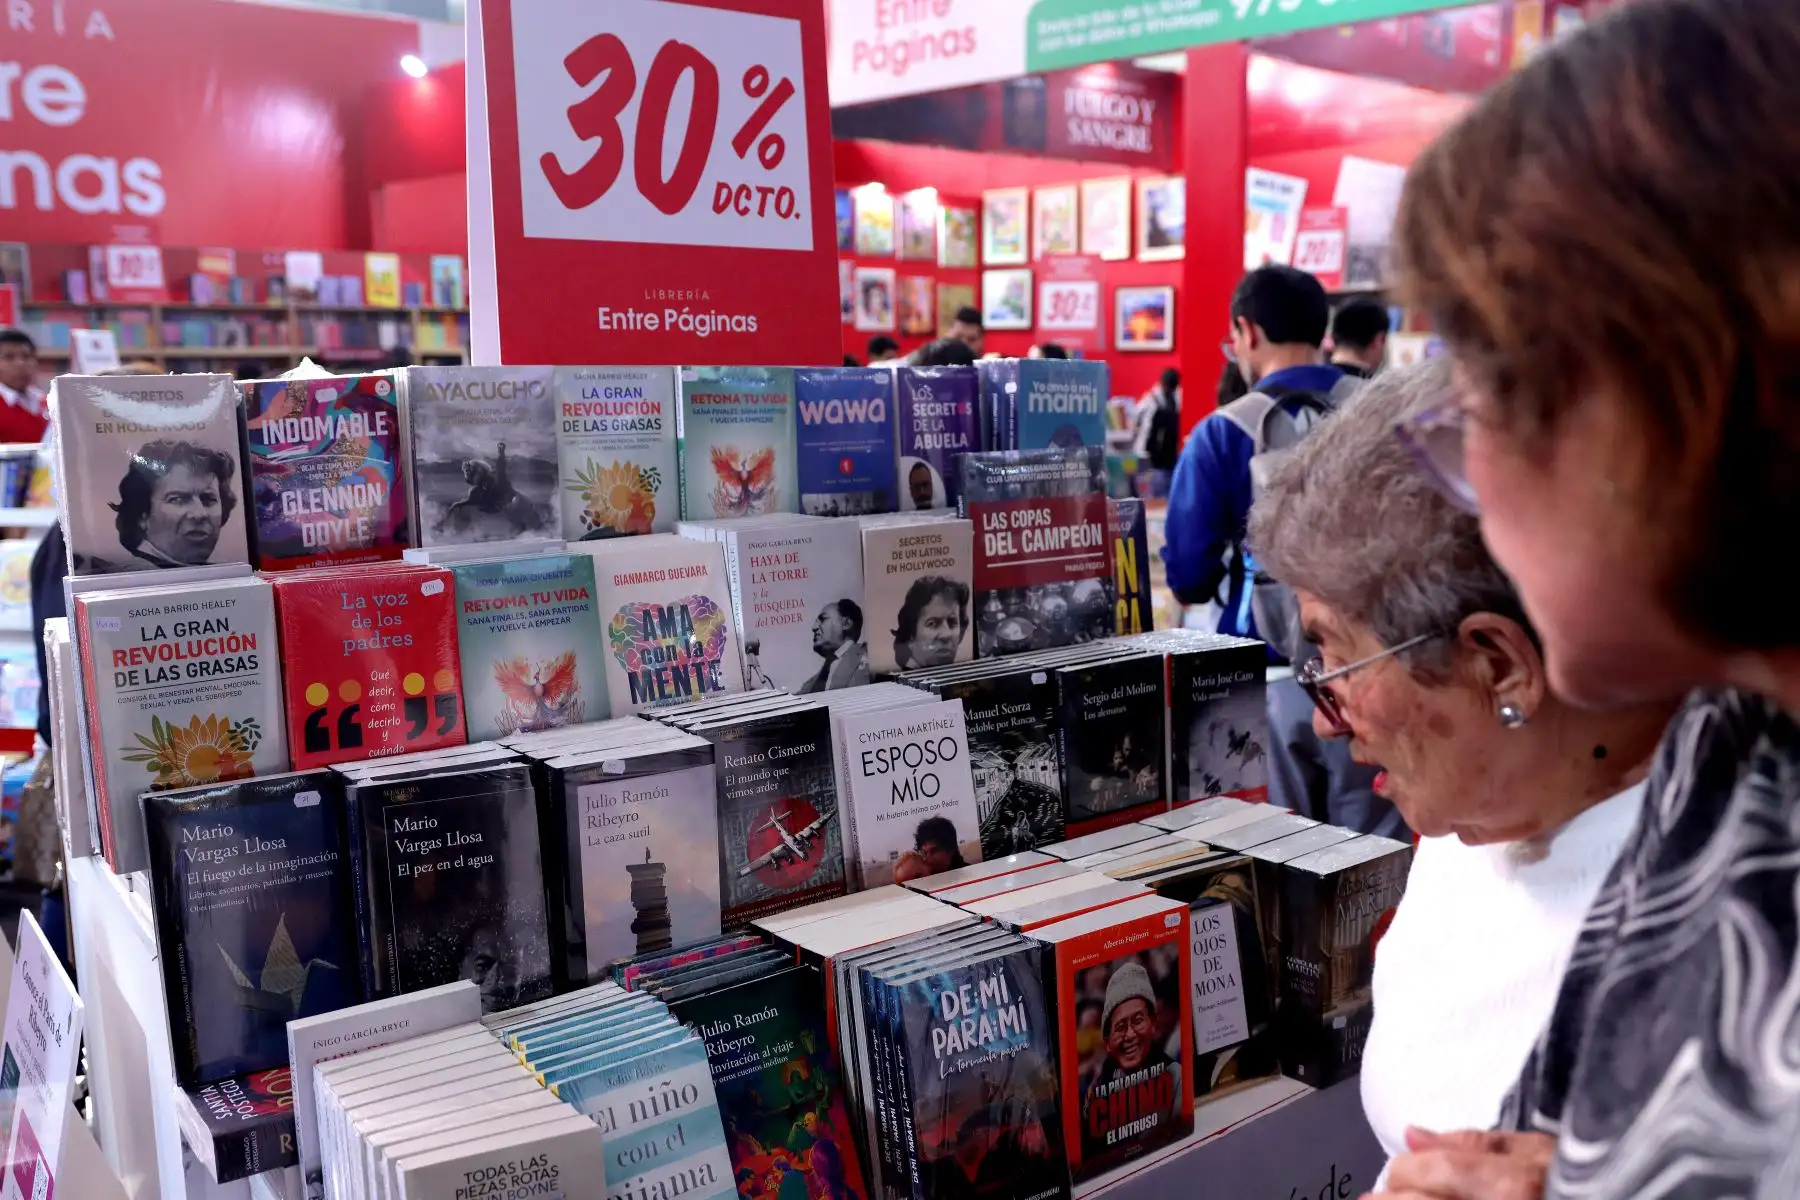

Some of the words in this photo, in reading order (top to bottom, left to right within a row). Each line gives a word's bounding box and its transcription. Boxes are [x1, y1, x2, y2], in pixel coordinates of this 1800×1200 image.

[852, 26, 978, 76] Páginas
[1064, 87, 1137, 123] FUEGO
[1138, 97, 1156, 125] Y
[0, 150, 166, 217] nas
[711, 181, 801, 220] DCTO.
[645, 288, 710, 301] LIBRERÍA
[598, 306, 660, 333] Entre
[664, 303, 758, 338] Páginas
[423, 380, 547, 402] AYACUCHO
[582, 388, 600, 400] LA
[604, 386, 643, 399] GRAN
[1028, 387, 1098, 415] mami
[562, 398, 662, 417] REVOLUCIÓN
[798, 398, 887, 426] wawa
[261, 411, 389, 446] INDOMABLE
[562, 420, 580, 433] DE
[583, 419, 609, 432] LAS
[611, 418, 663, 432] GRASAS
[914, 432, 970, 450] ABUELA
[986, 475, 1004, 484] CLUB
[1005, 471, 1052, 483] UNIVERSITARIO
[281, 483, 384, 517] GLENNON
[301, 516, 371, 548] DOYLE
[983, 511, 1008, 531] LAS
[1011, 507, 1052, 528] COPAS
[898, 534, 943, 549] SECRETOS
[985, 531, 1018, 557] DEL
[1021, 519, 1104, 553] CAMPEÓN
[750, 554, 782, 568] HAYA
[784, 551, 801, 564] DE
[891, 549, 904, 561] DE
[904, 549, 918, 560] UN
[918, 546, 950, 559] LATINO
[613, 570, 667, 587] GIANMARCO
[668, 564, 709, 581] GUEVARA
[751, 571, 769, 585] LA
[771, 567, 809, 582] TORRE
[128, 606, 162, 619] SACHA
[163, 602, 200, 615] BARRIO
[201, 598, 237, 611] HEALEY
[340, 592, 367, 611] La
[372, 592, 410, 607] voz
[463, 594, 529, 614] RETOMA
[529, 591, 551, 606] TU
[553, 586, 590, 602] VIDA
[140, 625, 168, 643] LA
[173, 616, 231, 639] GRAN
[351, 612, 372, 630] de
[376, 612, 403, 628] los
[641, 603, 696, 642] AMA
[112, 631, 258, 669] REVOLUCIÓN
[342, 630, 414, 657] padres
[641, 645, 679, 665] con
[684, 639, 705, 661] la
[114, 669, 140, 689] DE
[144, 663, 182, 685] LAS
[186, 654, 260, 680] GRASAS
[370, 669, 391, 682] Qué
[627, 659, 726, 705] MENTE
[1216, 671, 1235, 686] José
[116, 694, 149, 706] CONSIGA
[148, 692, 158, 701] EL
[158, 688, 195, 701] BIENESTAR
[368, 685, 396, 698] decir,
[1083, 691, 1111, 707] Sergio
[1110, 686, 1126, 700] del
[1124, 681, 1157, 698] Molino
[369, 702, 397, 714] cómo
[963, 705, 1000, 722] Manuel
[1000, 701, 1032, 716] Scorza
[367, 716, 402, 730] decirlo
[858, 727, 904, 744] CYNTHIA
[907, 717, 956, 736] MARTÍNEZ
[367, 743, 406, 758] cuándo
[724, 754, 766, 770] Renato
[767, 740, 816, 760] Cisneros
[861, 736, 959, 778] ESPOSO
[725, 774, 737, 787] El
[738, 769, 772, 784] mundo
[772, 765, 790, 781] que
[890, 767, 941, 806] MÍO
[585, 794, 618, 814] Julio
[621, 785, 670, 804] Ramón
[726, 786, 754, 801] vimos
[755, 780, 780, 796] arder
[586, 810, 640, 831] Ribeyro
[876, 812, 886, 823] Mi
[886, 808, 911, 822] historia
[910, 804, 930, 817] íntima
[929, 801, 942, 813] con
[941, 798, 960, 810] Pedro
[182, 823, 235, 844] Mario
[394, 816, 439, 833] Mario
[587, 834, 602, 847] La
[603, 832, 627, 845] caza
[628, 824, 652, 840] sutil
[184, 844, 240, 865] Vargas
[243, 836, 288, 855] Llosa
[395, 837, 443, 855] Vargas
[446, 831, 484, 847] Llosa
[186, 872, 200, 886] El
[203, 868, 237, 884] fuego
[238, 863, 254, 877] de
[256, 860, 268, 873] la
[268, 850, 339, 872] imaginación
[1194, 914, 1221, 936] LOS
[1193, 933, 1228, 957] OJOS
[1203, 955, 1223, 976] DE
[1286, 961, 1320, 979] MARTIN
[1194, 972, 1237, 999] MONA
[28, 1003, 47, 1052] Ribeyro
[701, 1019, 732, 1042] Julio
[732, 1004, 780, 1030] Ramón
[704, 1033, 756, 1059] Ribeyro
[708, 1050, 761, 1076] Invitación
[761, 1045, 772, 1059] al
[771, 1038, 796, 1057] viaje
[712, 1078, 719, 1087] y
[718, 1071, 738, 1085] otros
[737, 1064, 764, 1079] cuentos
[762, 1054, 790, 1071] inéditos
[940, 1060, 956, 1081] La
[956, 1050, 999, 1071] tormenta
[1089, 1072, 1175, 1139] CHINO
[1106, 1130, 1118, 1146] EL
[1118, 1112, 1159, 1141] INTRUSO
[617, 1140, 659, 1168] con
[665, 1123, 686, 1151] el
[455, 1176, 510, 1200] PIEZAS
[510, 1164, 560, 1189] ROTAS
[463, 1163, 518, 1186] TODAS
[519, 1153, 549, 1176] LAS
